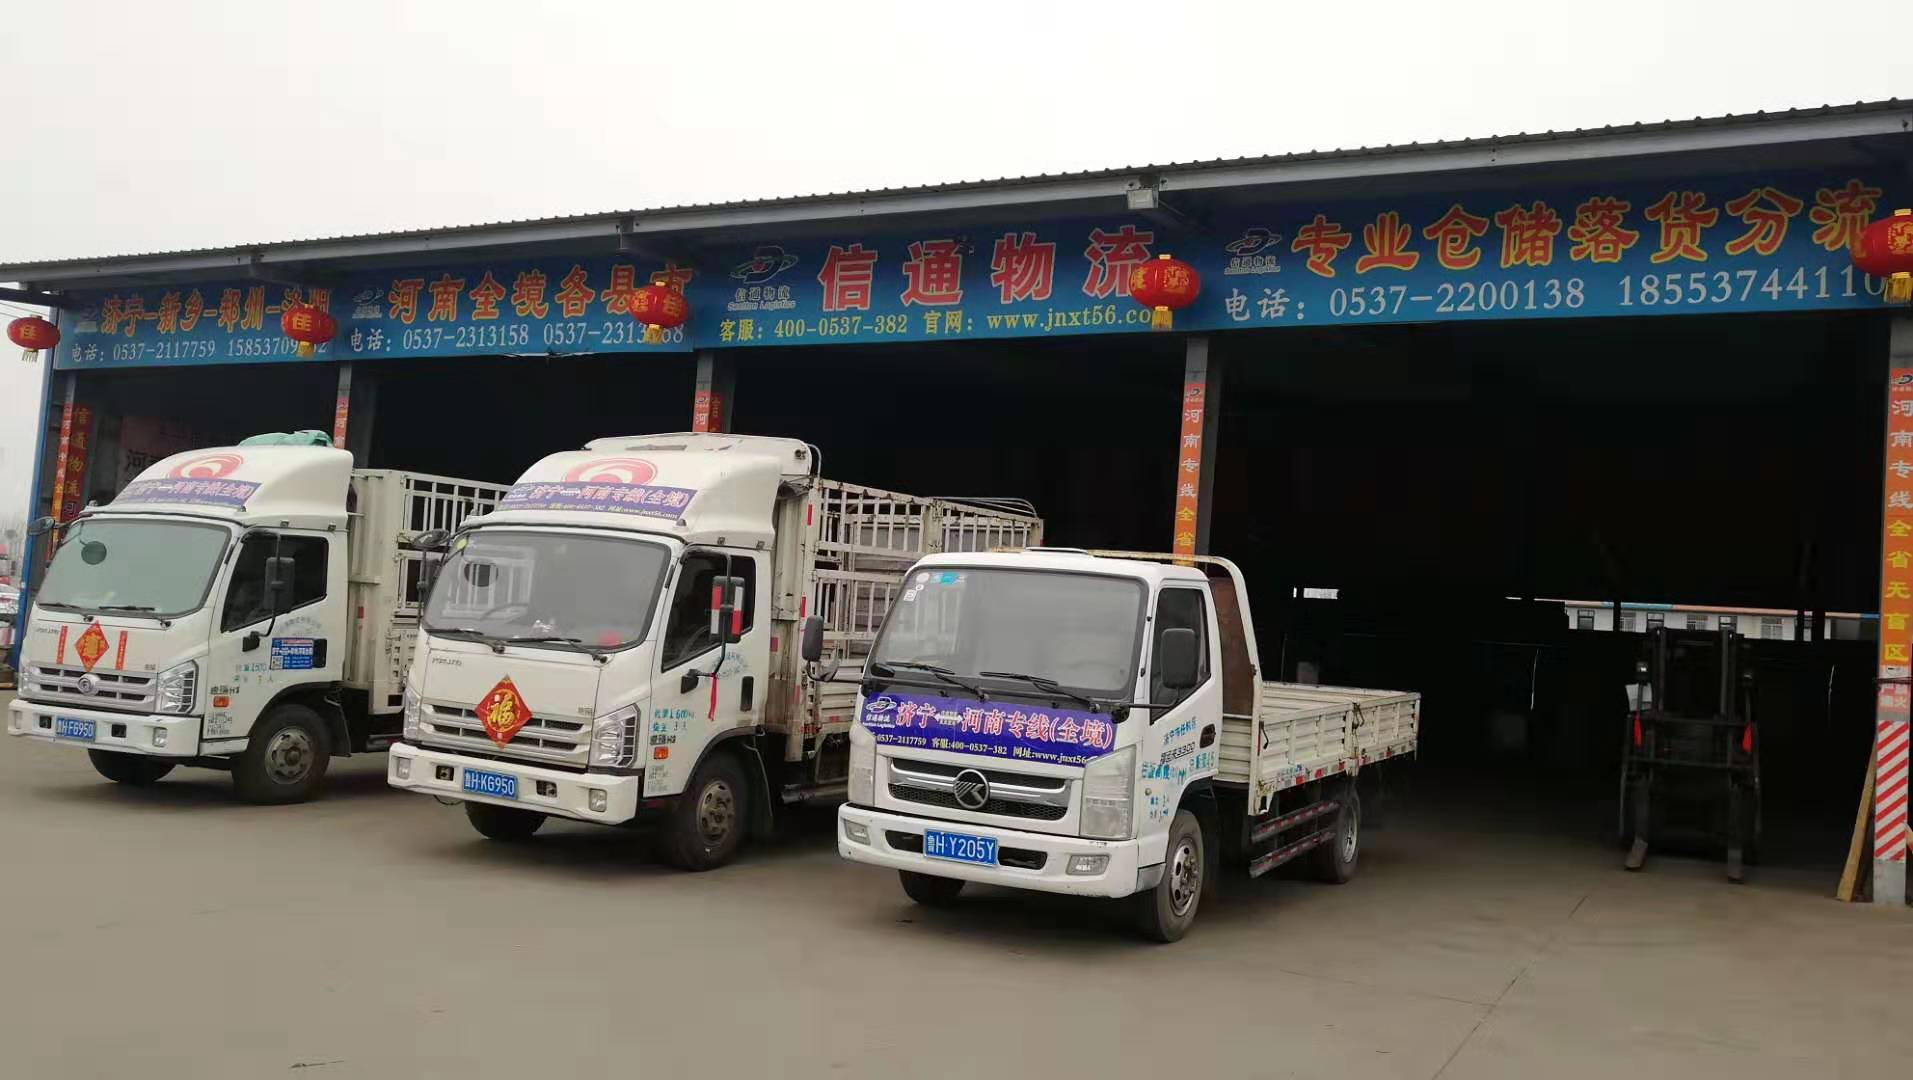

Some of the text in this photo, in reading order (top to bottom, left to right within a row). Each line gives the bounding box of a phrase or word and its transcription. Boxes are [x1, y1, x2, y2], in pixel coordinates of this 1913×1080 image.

[1291, 179, 1882, 278] 专业仓储落货分流
[816, 224, 1154, 312] 信通物流
[1617, 264, 1885, 308] 18553744110
[228, 336, 328, 356] 158537092
[543, 321, 684, 346] 0537-231368
[1174, 408, 1203, 564] 河南专线全省
[896, 700, 1113, 750] 济宁 河南专线(全境)
